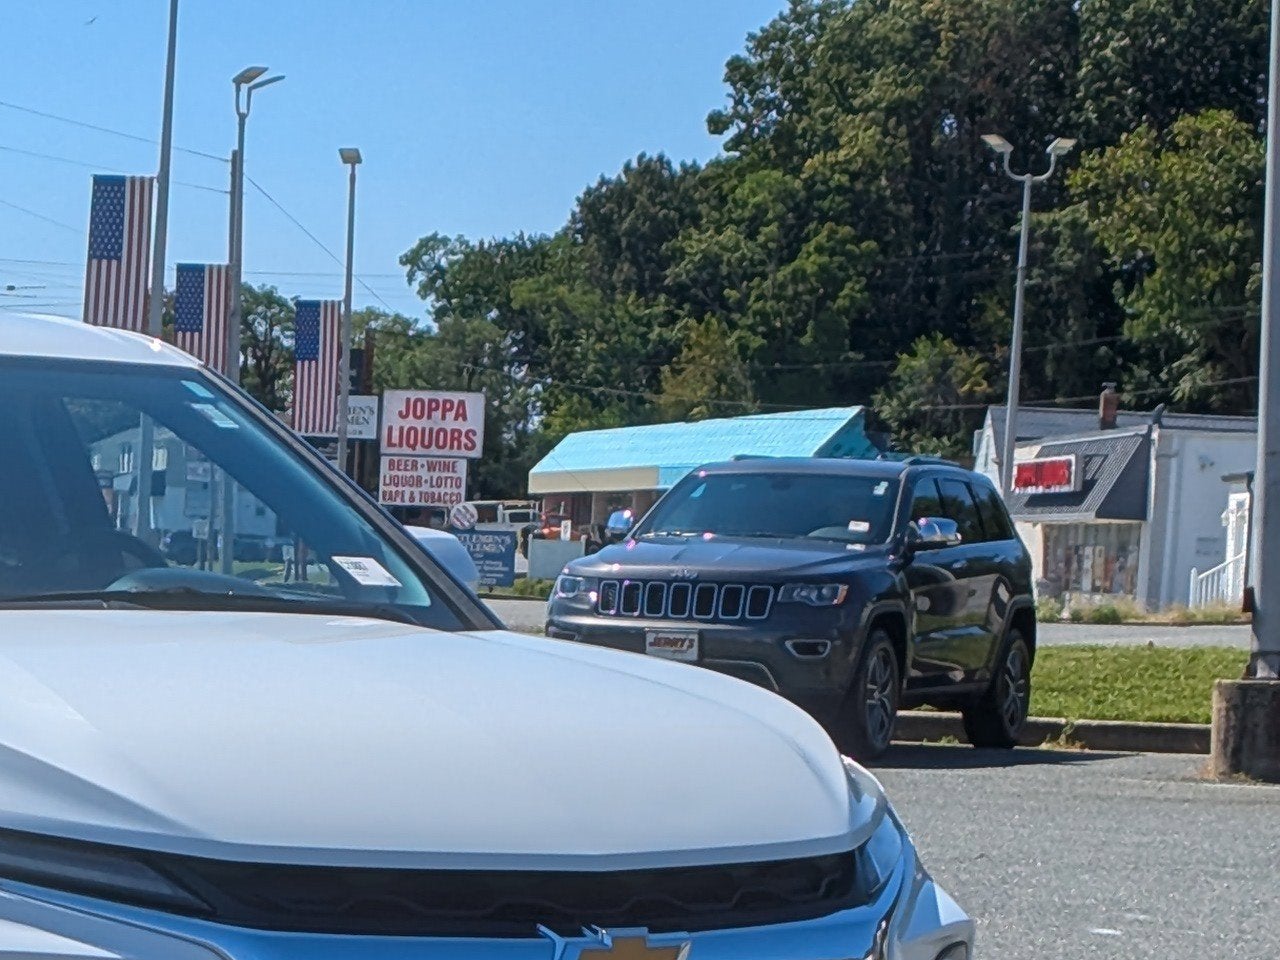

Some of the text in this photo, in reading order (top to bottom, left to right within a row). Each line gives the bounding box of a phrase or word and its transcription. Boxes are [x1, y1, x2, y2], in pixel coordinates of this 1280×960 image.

[398, 397, 468, 422] JOPPA
[386, 425, 478, 451] LIQUORS
[388, 458, 459, 473] BEER WINE
[382, 474, 462, 489] LIQUOR LOTTO
[419, 491, 462, 505] TOBACCO
